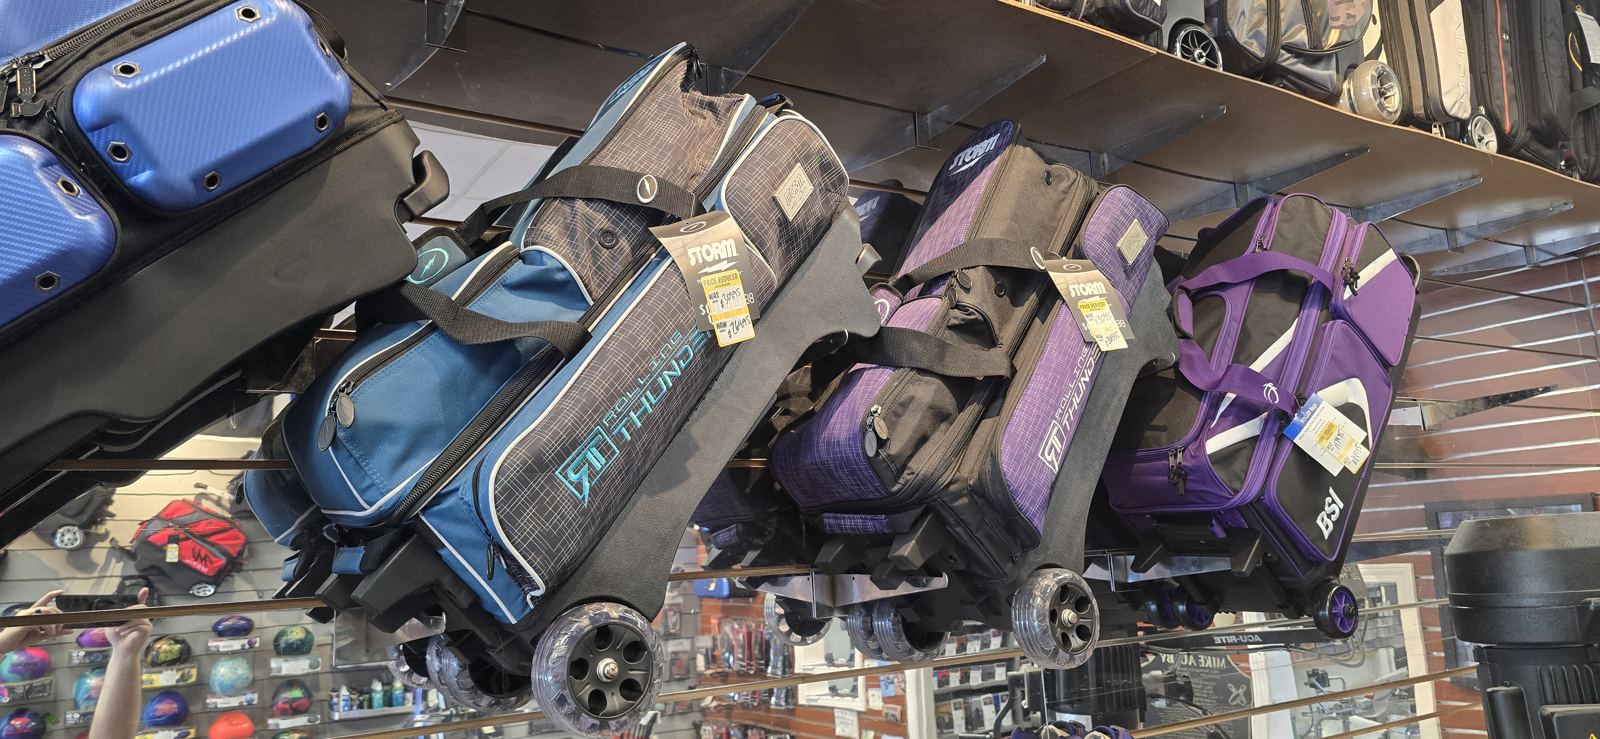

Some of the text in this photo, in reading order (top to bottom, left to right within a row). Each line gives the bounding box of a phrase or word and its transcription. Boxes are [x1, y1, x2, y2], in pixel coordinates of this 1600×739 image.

[948, 133, 1001, 171] STORM
[687, 238, 738, 266] STORM
[1068, 281, 1107, 298] STORM
[602, 330, 682, 427] ROLLING
[611, 328, 712, 441] THUNDE
[1055, 347, 1090, 420] ROLLING
[1062, 341, 1103, 431] THUNDE
[1315, 486, 1344, 540] BSI
